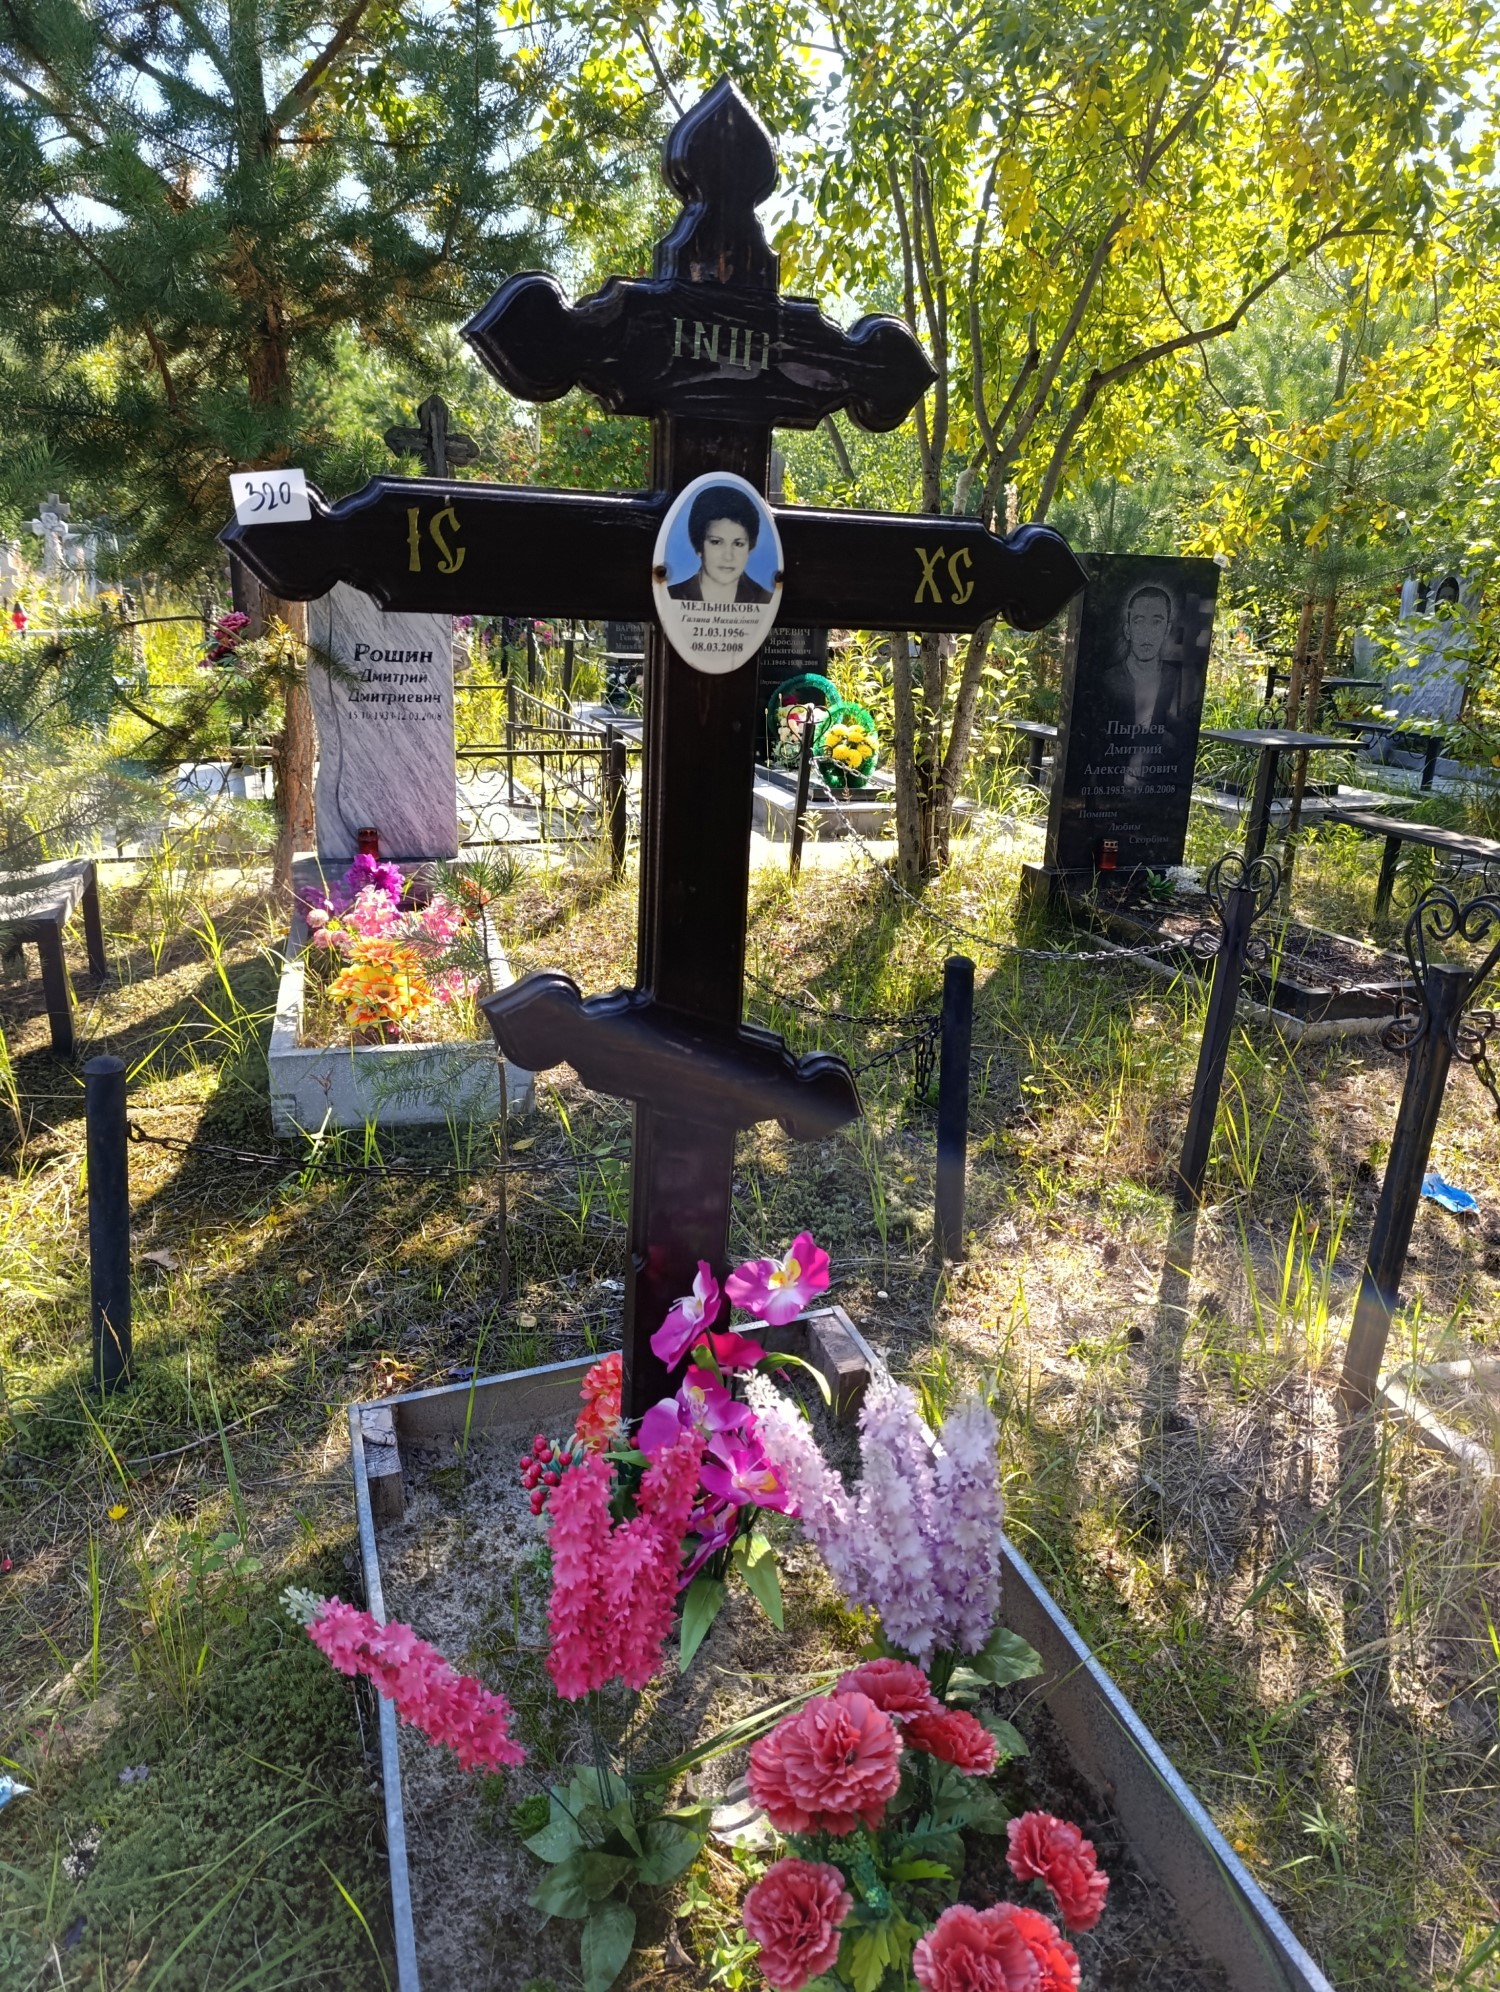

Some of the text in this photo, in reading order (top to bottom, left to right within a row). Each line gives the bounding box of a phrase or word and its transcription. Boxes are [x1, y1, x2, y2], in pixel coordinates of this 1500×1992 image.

[245, 481, 291, 512] 320
[680, 601, 761, 613] МЕЛЬНИКОВА
[681, 614, 711, 624] Галина
[361, 668, 428, 685] Дмитрий
[348, 690, 442, 706] Дмитриевич
[1106, 720, 1165, 739] Пырьев
[1104, 743, 1163, 757] Дмитрий
[1081, 786, 1126, 796] 01.08.1983
[1133, 785, 1176, 795] 19.08.2008
[1079, 809, 1119, 819] Помним
[1107, 823, 1142, 833] Любим
